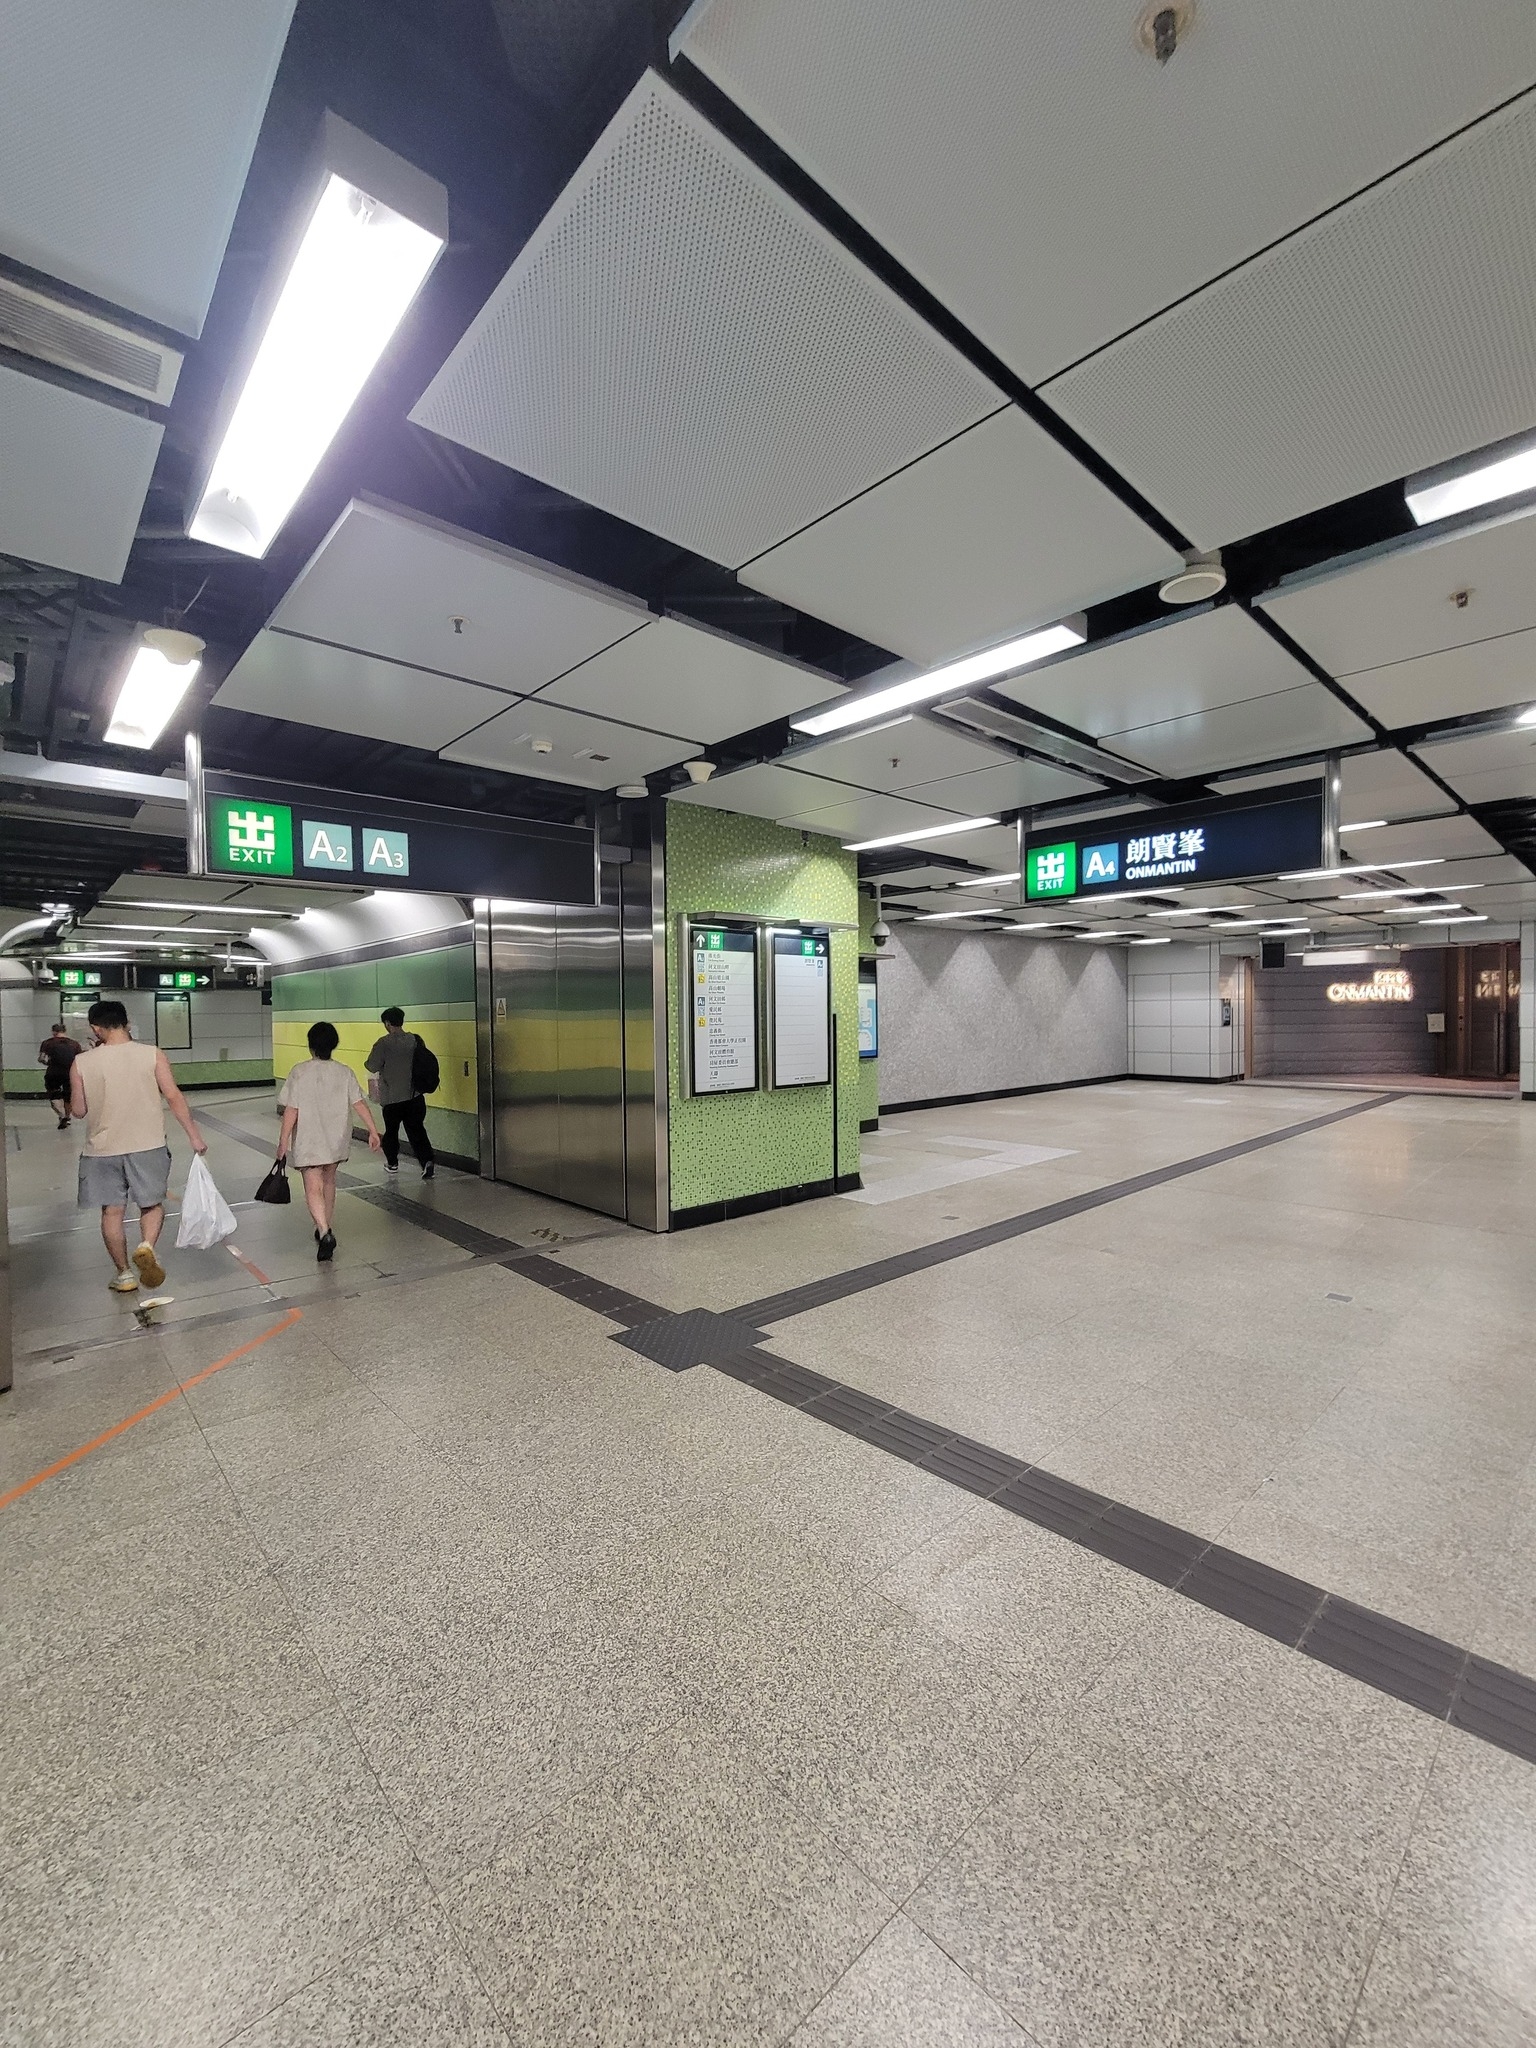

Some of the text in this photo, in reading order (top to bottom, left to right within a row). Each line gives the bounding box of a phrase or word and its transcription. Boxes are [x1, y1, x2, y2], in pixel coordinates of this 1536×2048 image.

[228, 811, 275, 850] 出
[229, 848, 275, 864] EXIT
[309, 830, 404, 868] A2 A3
[1125, 828, 1205, 864] 朗賢峯
[1037, 852, 1065, 880] 出
[1086, 852, 1115, 879] A4
[1125, 859, 1196, 880] ONMANTIN
[1037, 878, 1064, 891] EXIT
